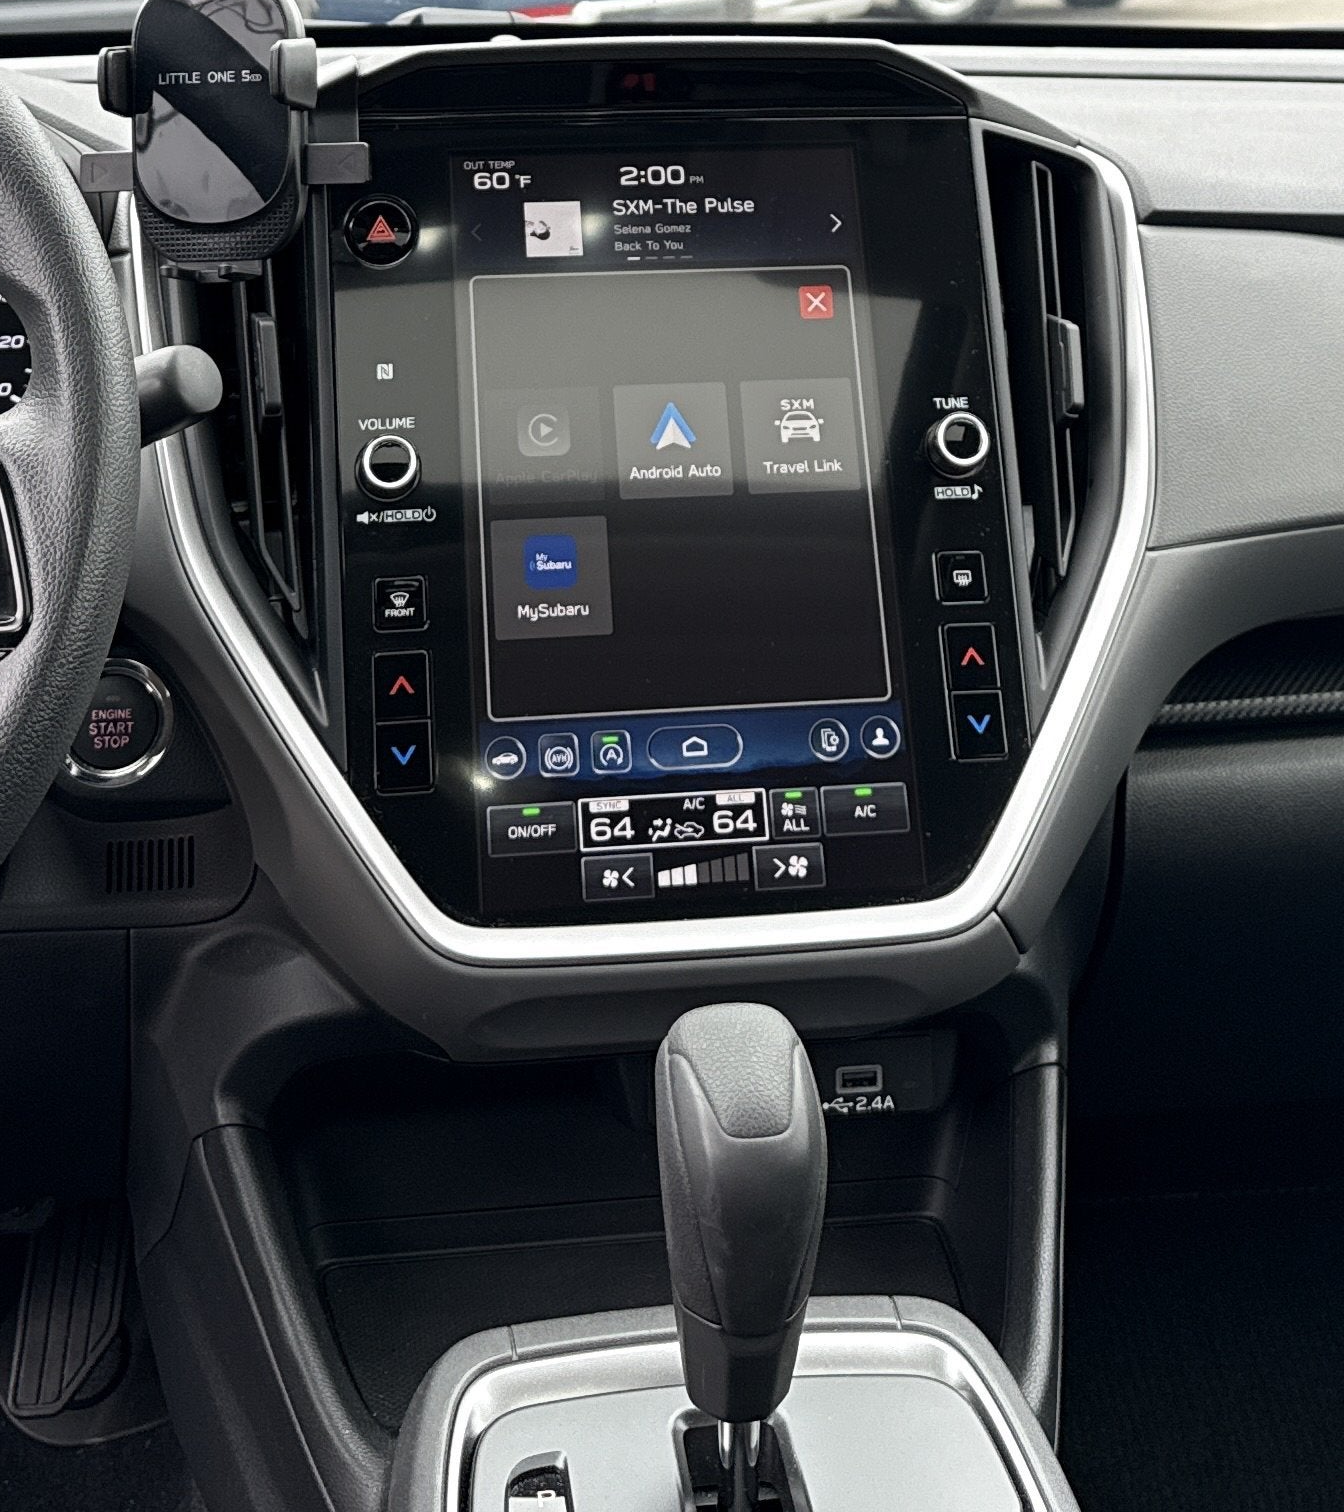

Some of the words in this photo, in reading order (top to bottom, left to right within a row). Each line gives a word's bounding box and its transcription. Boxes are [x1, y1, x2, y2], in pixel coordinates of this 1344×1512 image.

[158, 71, 201, 85] LITTLE
[207, 70, 236, 84] ONE
[463, 161, 485, 170] OUT
[488, 160, 515, 169] TEMP
[473, 171, 508, 190] 60
[619, 165, 686, 186] 2:00
[689, 175, 704, 184] PM
[612, 198, 698, 216] SXM-The
[704, 197, 755, 214] Pulse
[613, 224, 652, 235] Selena
[655, 223, 692, 234] Gomez
[614, 241, 642, 252] Back
[647, 240, 660, 251] To
[664, 240, 684, 251] You
[780, 399, 815, 411] SXM
[932, 397, 969, 409] TUNE
[358, 417, 416, 431] VOLUME
[630, 465, 684, 480] Android
[688, 464, 722, 477] Auto
[763, 460, 809, 475] Travel
[814, 458, 843, 472] Link
[935, 487, 971, 498] HOLD
[384, 510, 422, 522] HOLD
[536, 560, 573, 571] Subaru
[384, 607, 416, 618] FRONT
[517, 603, 590, 622] MySubaru
[91, 709, 133, 721] ENGINE
[88, 721, 135, 736] START
[93, 735, 130, 749] STOP
[683, 797, 705, 810] A/C
[727, 793, 745, 802] ALL
[595, 800, 623, 810] SYNC
[854, 804, 877, 818] A/C
[712, 809, 757, 834] 64
[783, 818, 810, 832] ALL
[507, 823, 557, 839] ON/OFF
[589, 816, 635, 842] 64
[855, 1095, 895, 1111] 2.4A
